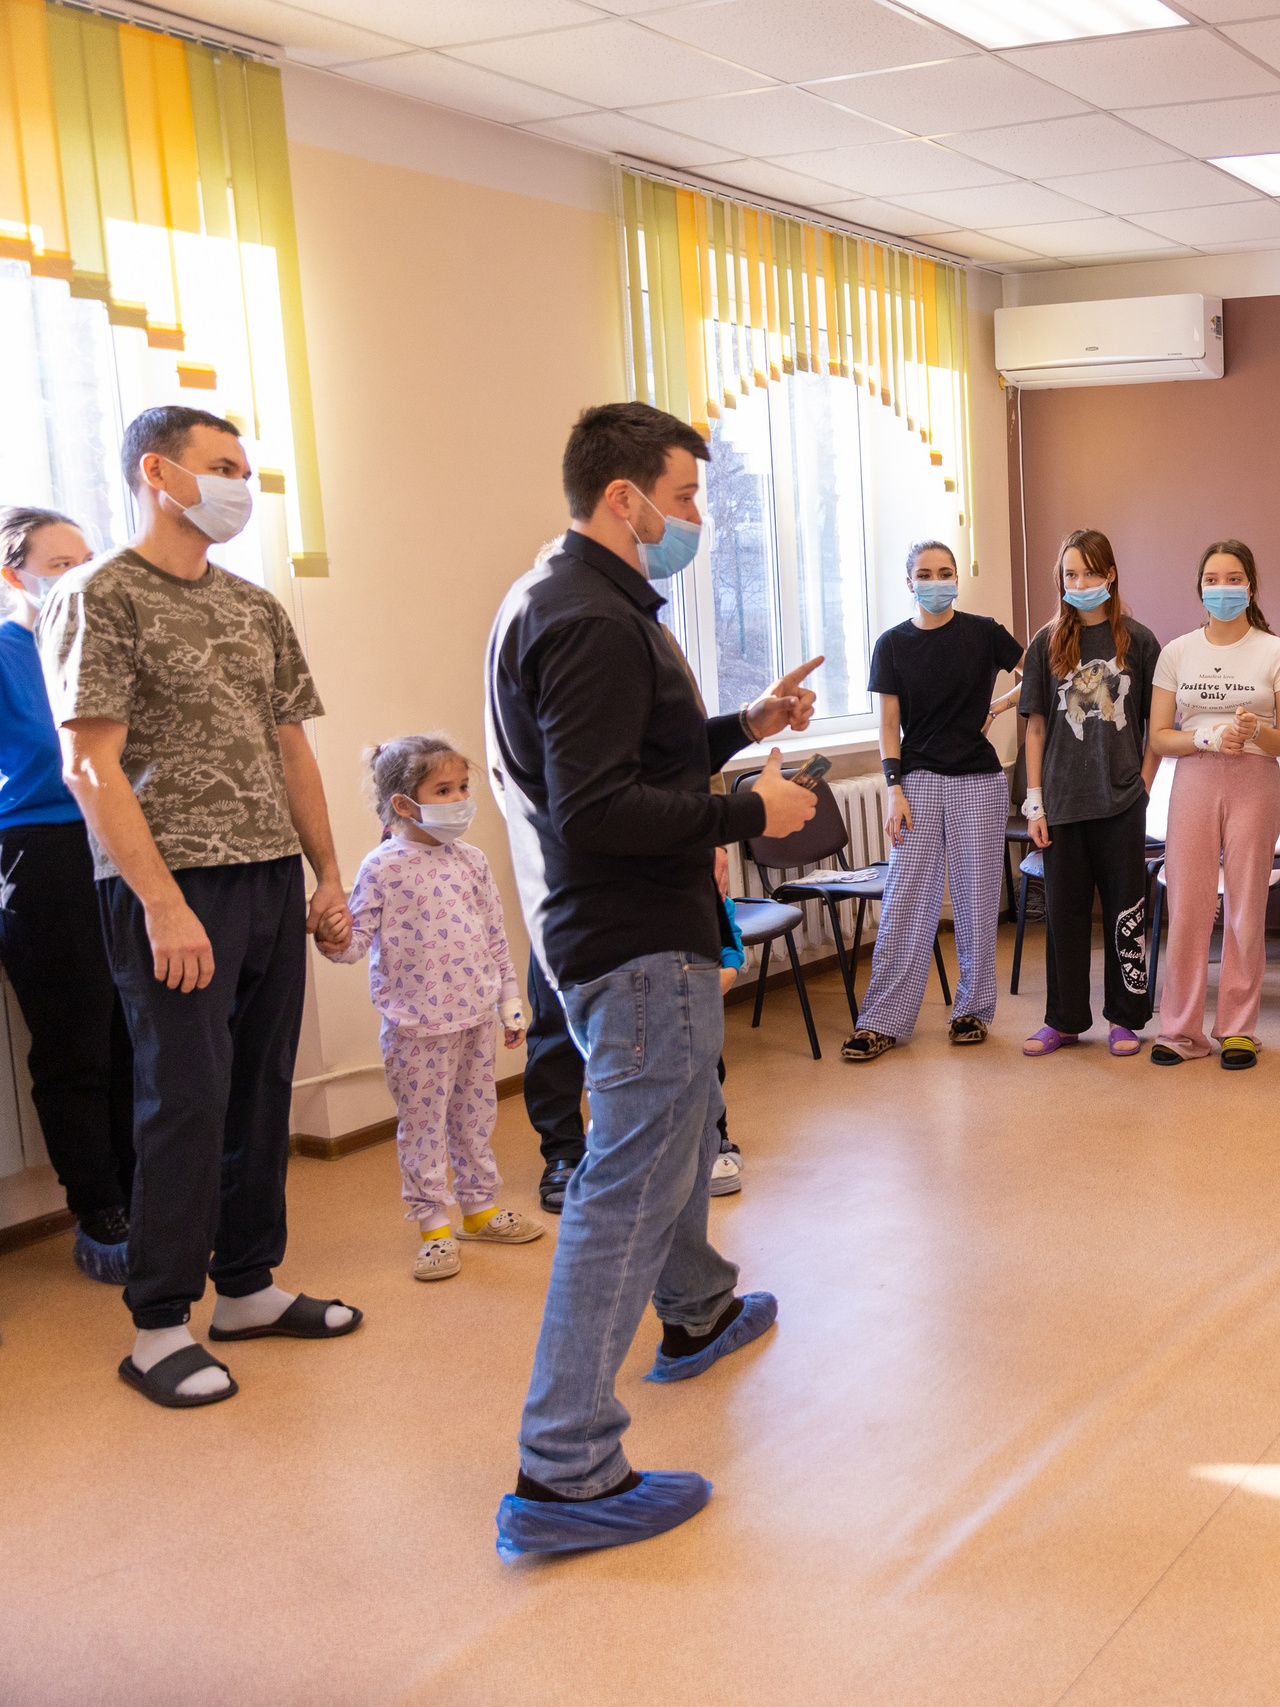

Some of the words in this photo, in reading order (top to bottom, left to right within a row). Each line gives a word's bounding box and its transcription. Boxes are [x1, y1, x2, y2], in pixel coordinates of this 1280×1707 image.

[1180, 682, 1219, 690] Positive
[1225, 683, 1255, 691] Vibes
[1200, 691, 1226, 700] Only
